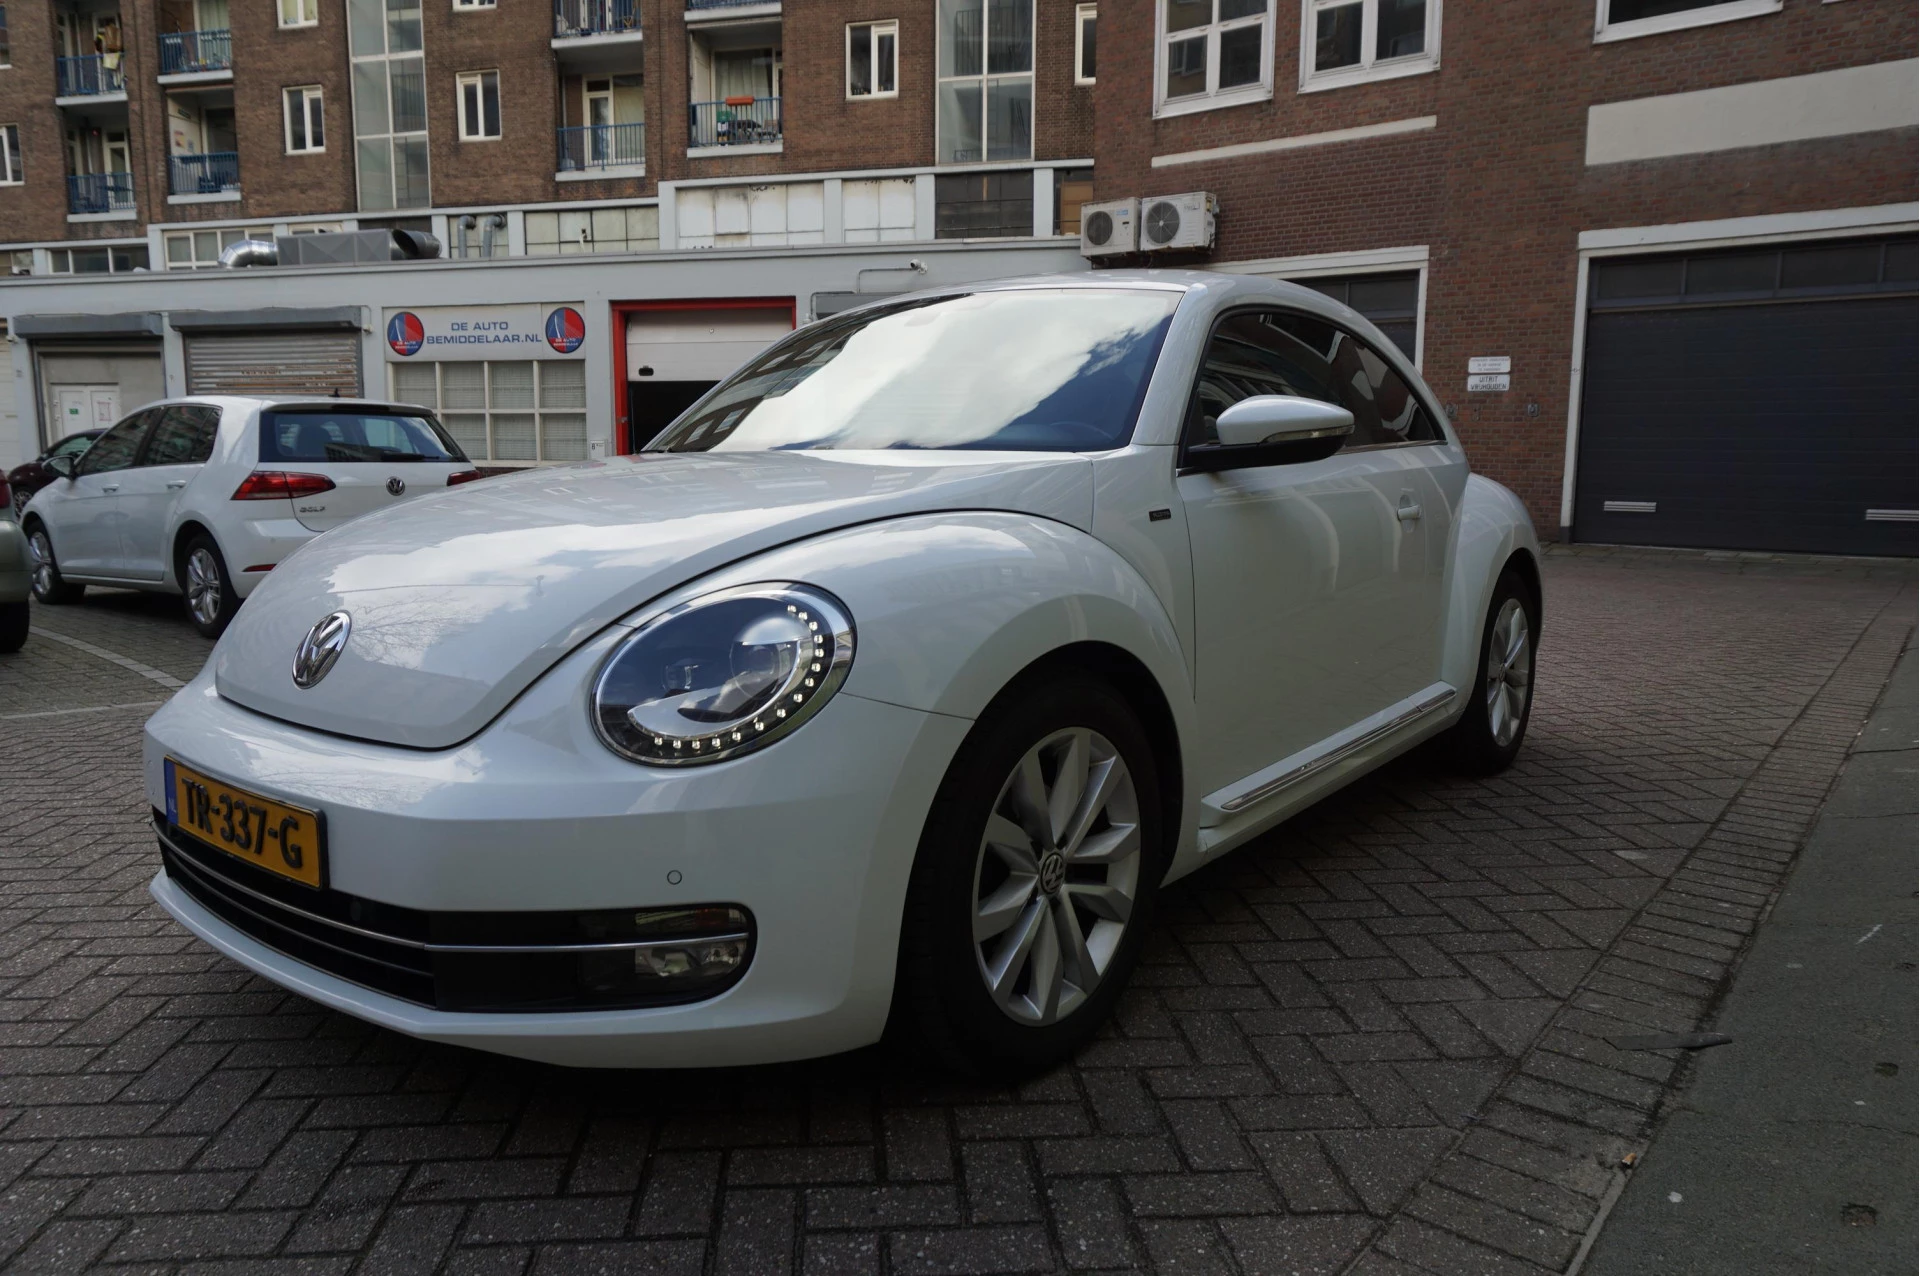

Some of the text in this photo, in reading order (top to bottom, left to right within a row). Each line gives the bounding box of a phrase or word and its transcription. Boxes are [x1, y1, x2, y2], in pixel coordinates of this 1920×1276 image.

[451, 321, 509, 332] DE AUTO
[426, 333, 542, 345] BEMIDDELAAR.NL
[1479, 375, 1499, 383] UITRIT
[181, 777, 303, 869] TR-337-G
